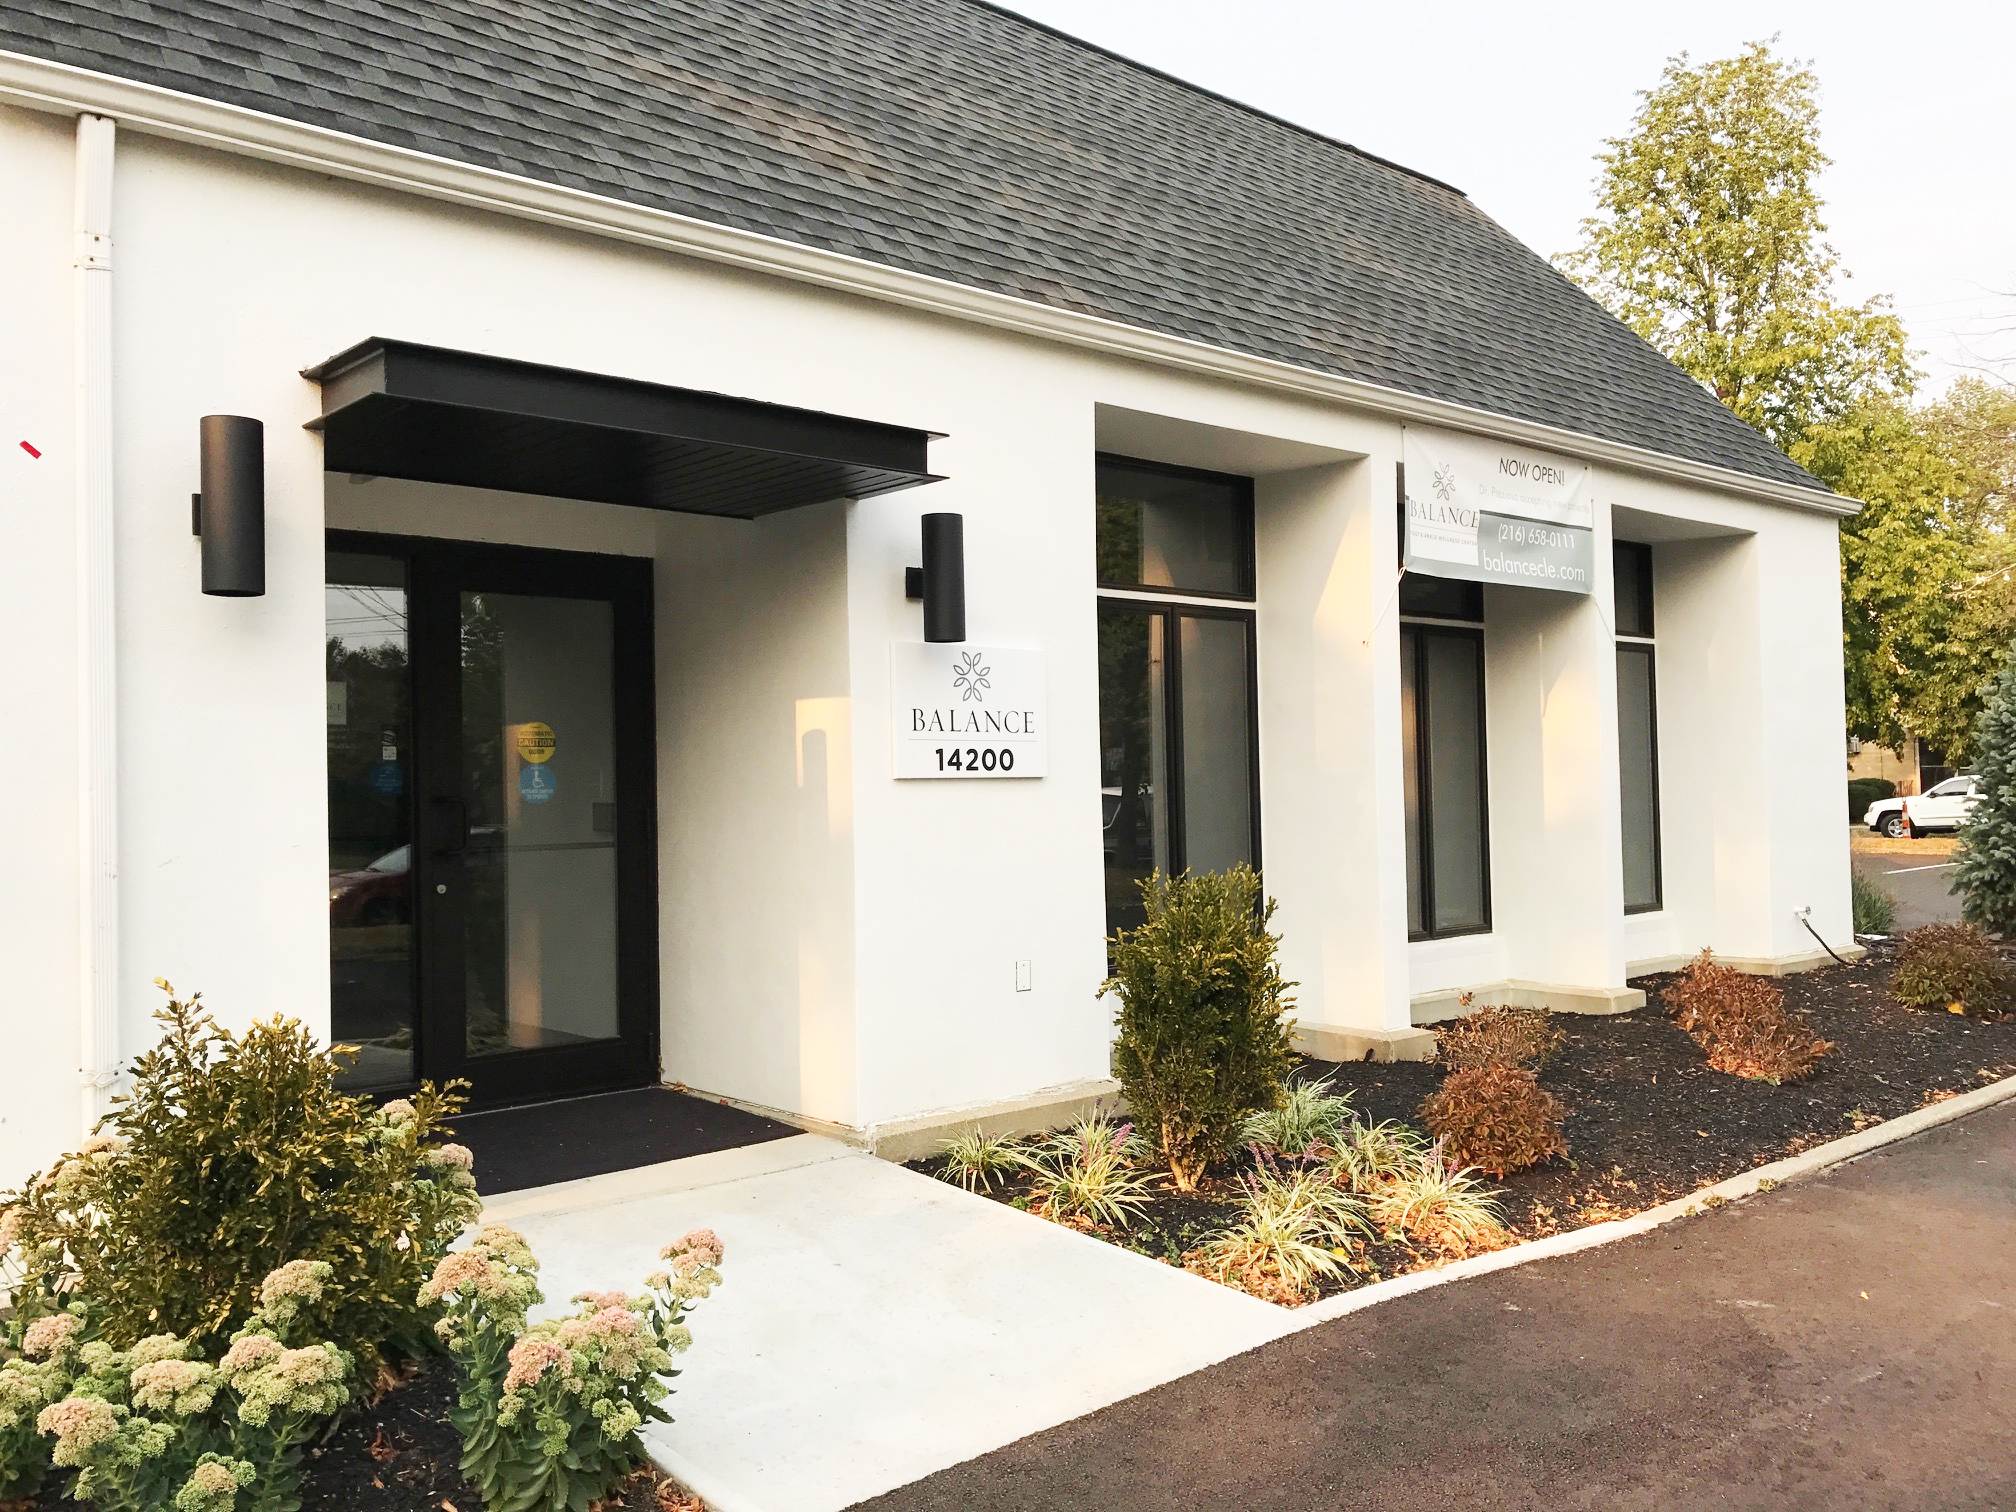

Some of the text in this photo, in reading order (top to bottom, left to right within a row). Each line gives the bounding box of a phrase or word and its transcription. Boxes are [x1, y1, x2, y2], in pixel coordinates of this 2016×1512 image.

[1499, 457, 1565, 486] NOW OPEN!
[1479, 484, 1490, 496] Dr.
[1491, 486, 1519, 502] Prezioso
[1520, 495, 1552, 509] accepting
[1410, 499, 1479, 529] BALANCE
[1498, 523, 1576, 549] (216) 658-0111
[1483, 549, 1585, 582] balancecle.com
[911, 708, 1035, 734] BALANCE
[518, 738, 554, 747] CAUTION
[935, 748, 1014, 771] 14200
